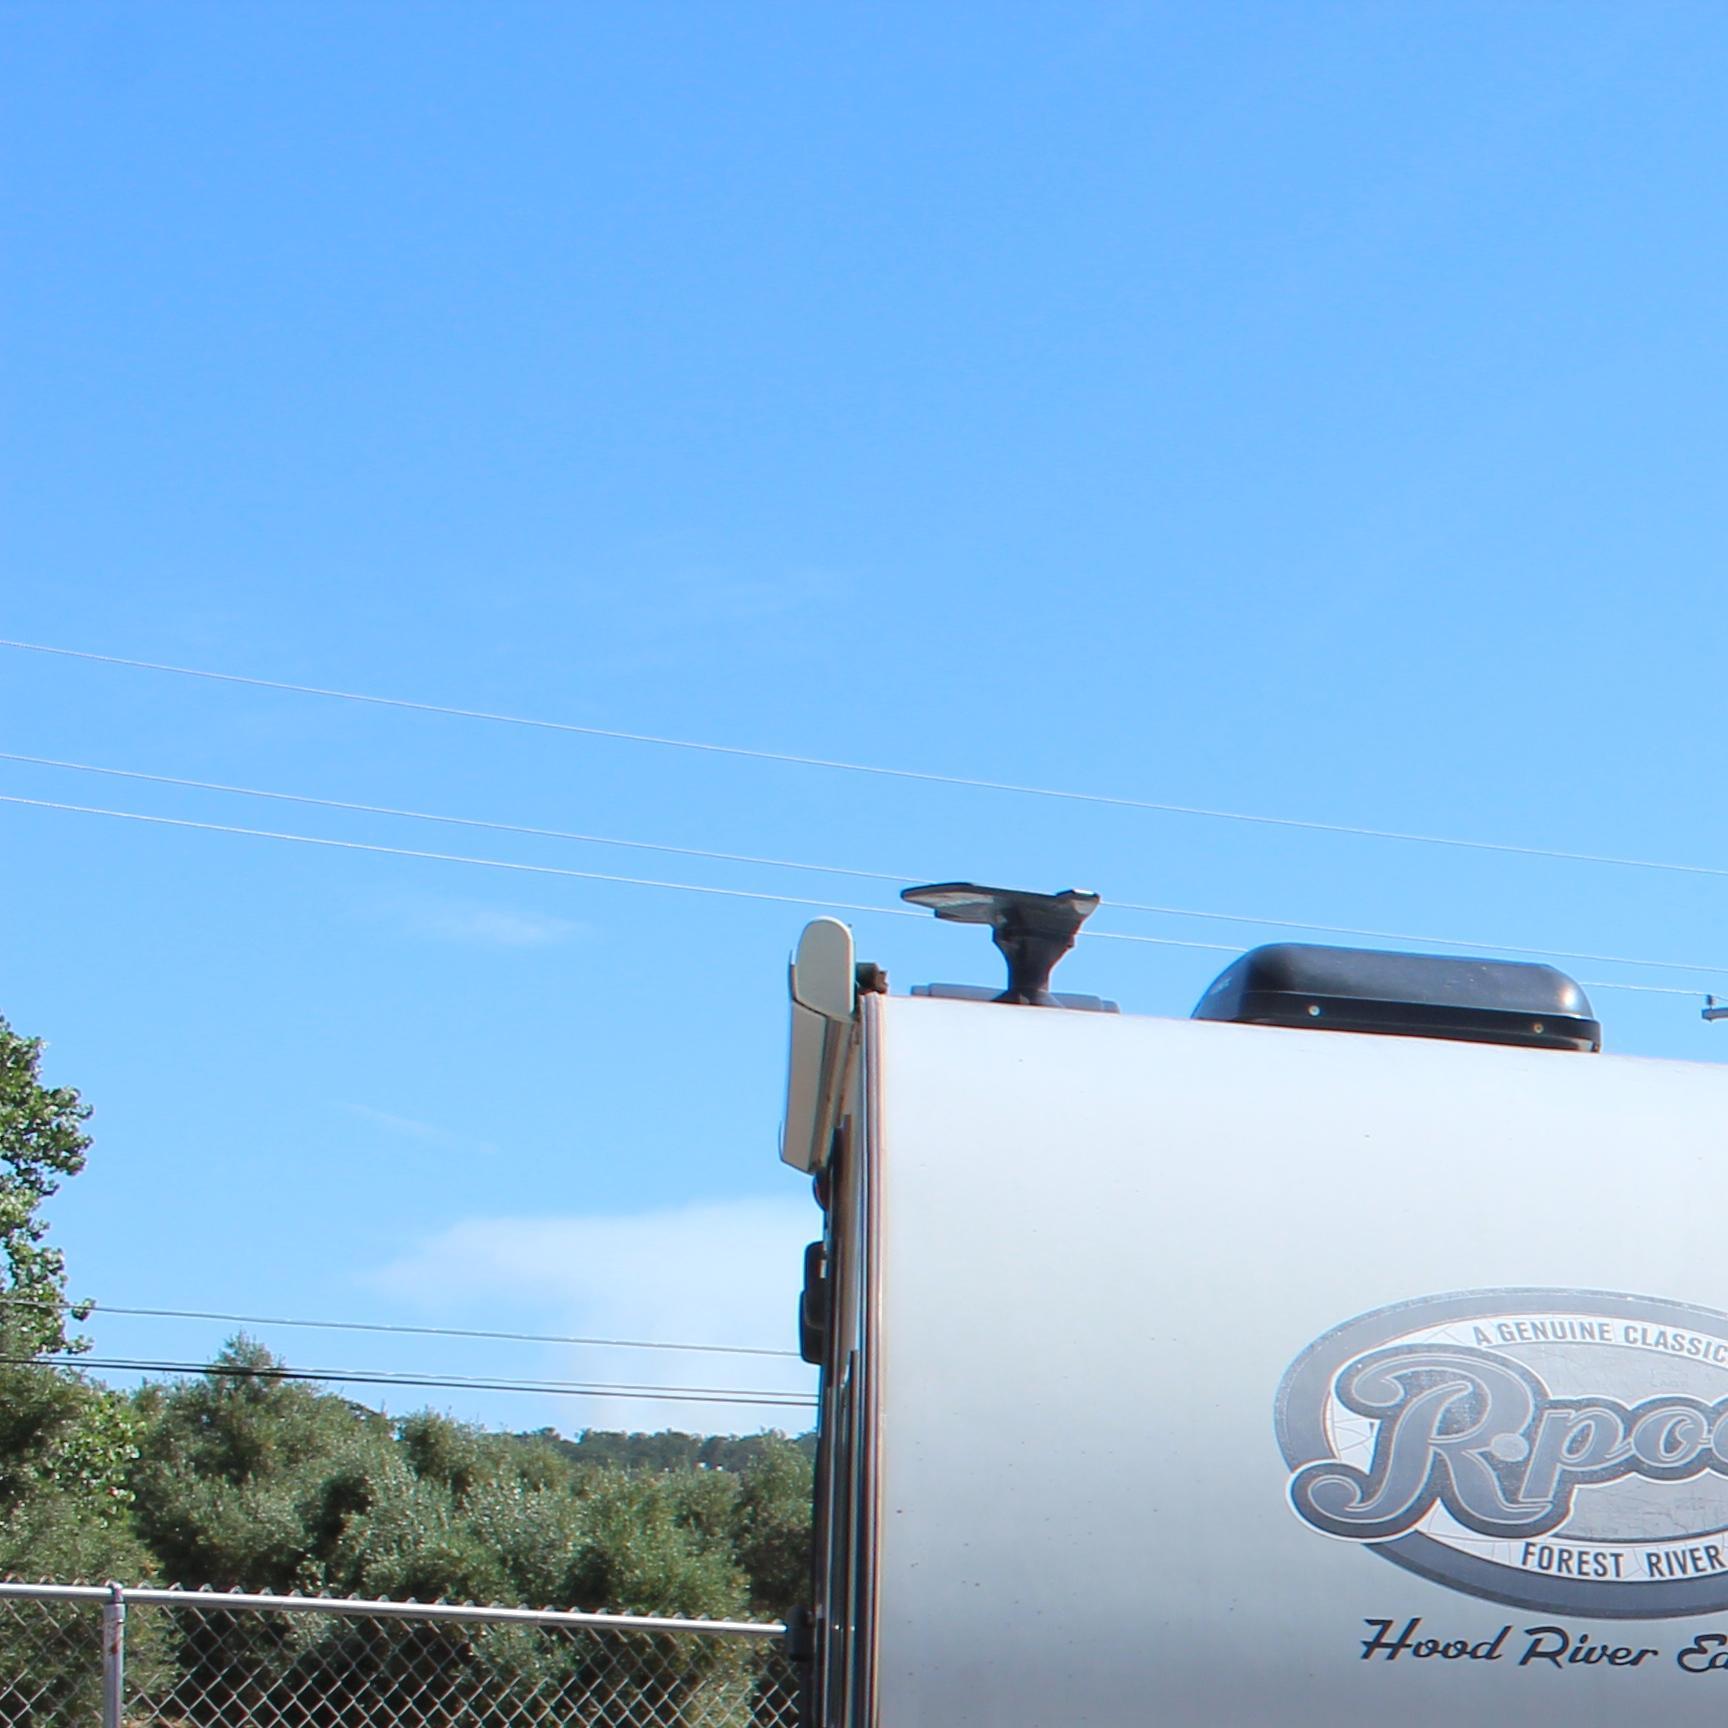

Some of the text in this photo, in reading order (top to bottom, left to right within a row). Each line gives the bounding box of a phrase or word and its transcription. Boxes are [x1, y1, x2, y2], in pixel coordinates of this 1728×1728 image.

[1472, 1325, 1493, 1346] A
[1497, 1321, 1613, 1343] GENUINE
[1520, 1541, 1728, 1579] FOREST RIVER
[1360, 1617, 1513, 1660] Hood
[1518, 1626, 1659, 1669] River
